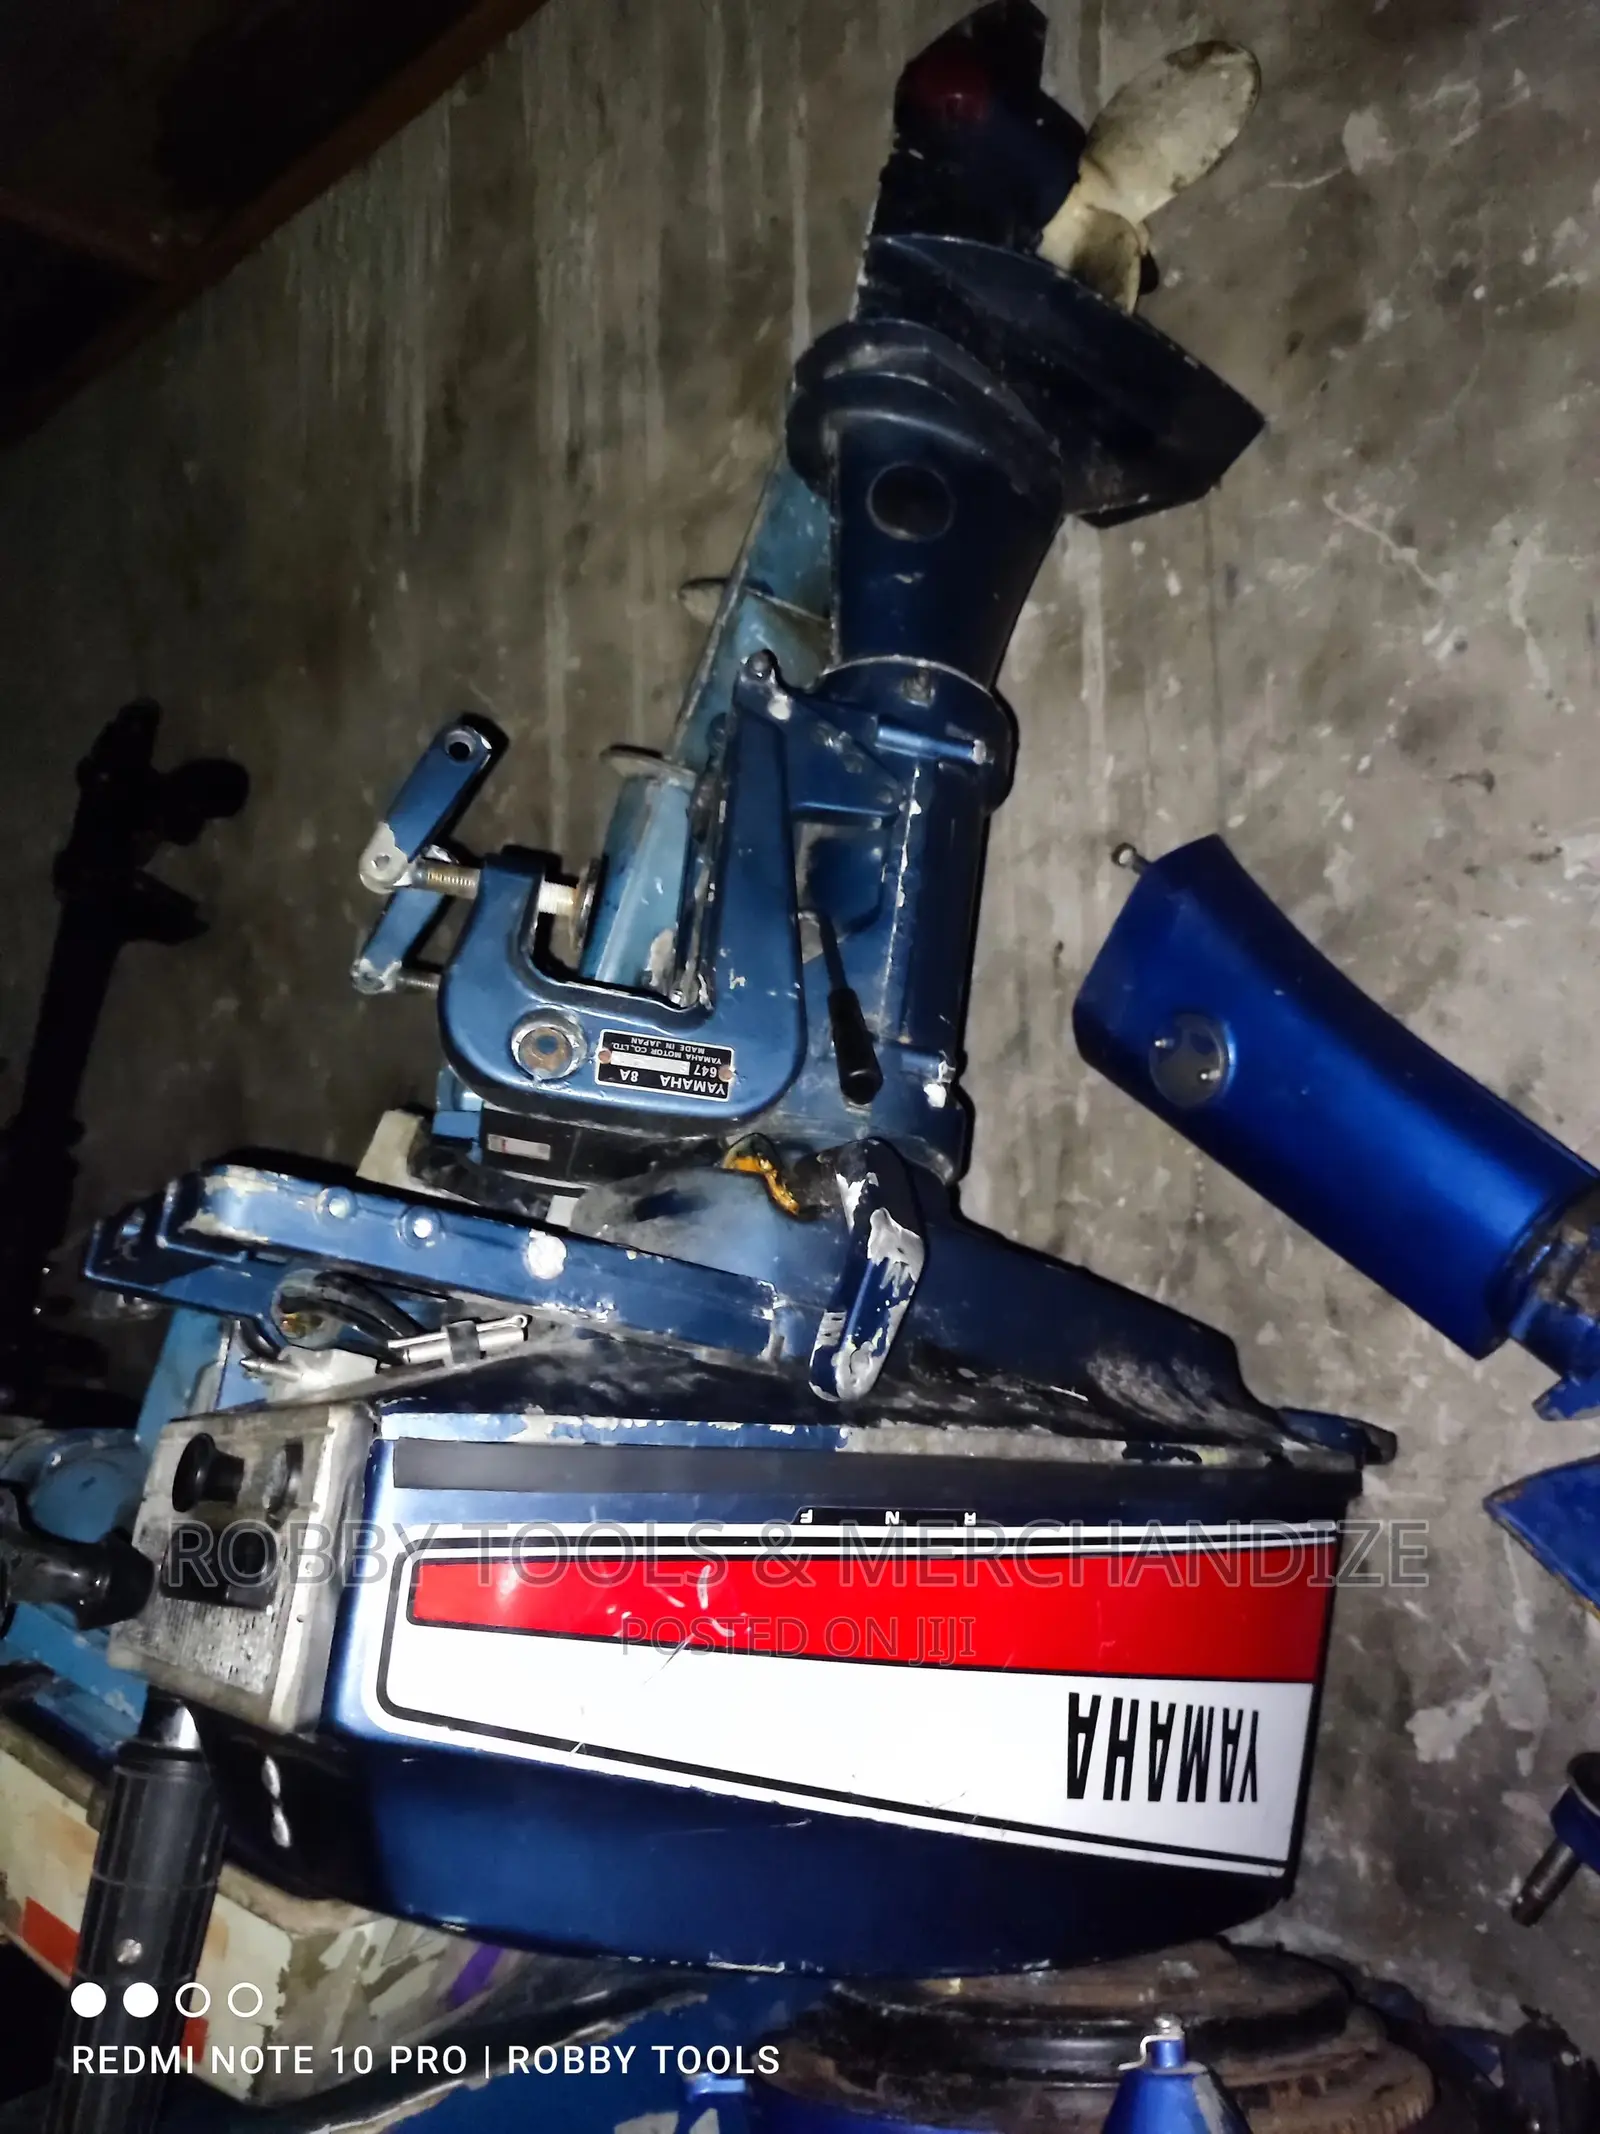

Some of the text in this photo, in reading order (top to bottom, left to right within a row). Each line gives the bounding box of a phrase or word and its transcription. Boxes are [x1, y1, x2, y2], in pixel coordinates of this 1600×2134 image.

[630, 1037, 705, 1054] MADE IN JAPAN
[650, 1048, 681, 1058] MOTOR
[685, 1053, 721, 1064] YAMAHA
[693, 1063, 718, 1078] 647
[619, 1068, 725, 1095] YAMAHA 8A
[799, 1509, 814, 1524] F
[884, 1510, 900, 1525] N
[1065, 1691, 1260, 1804] YAMAHA
